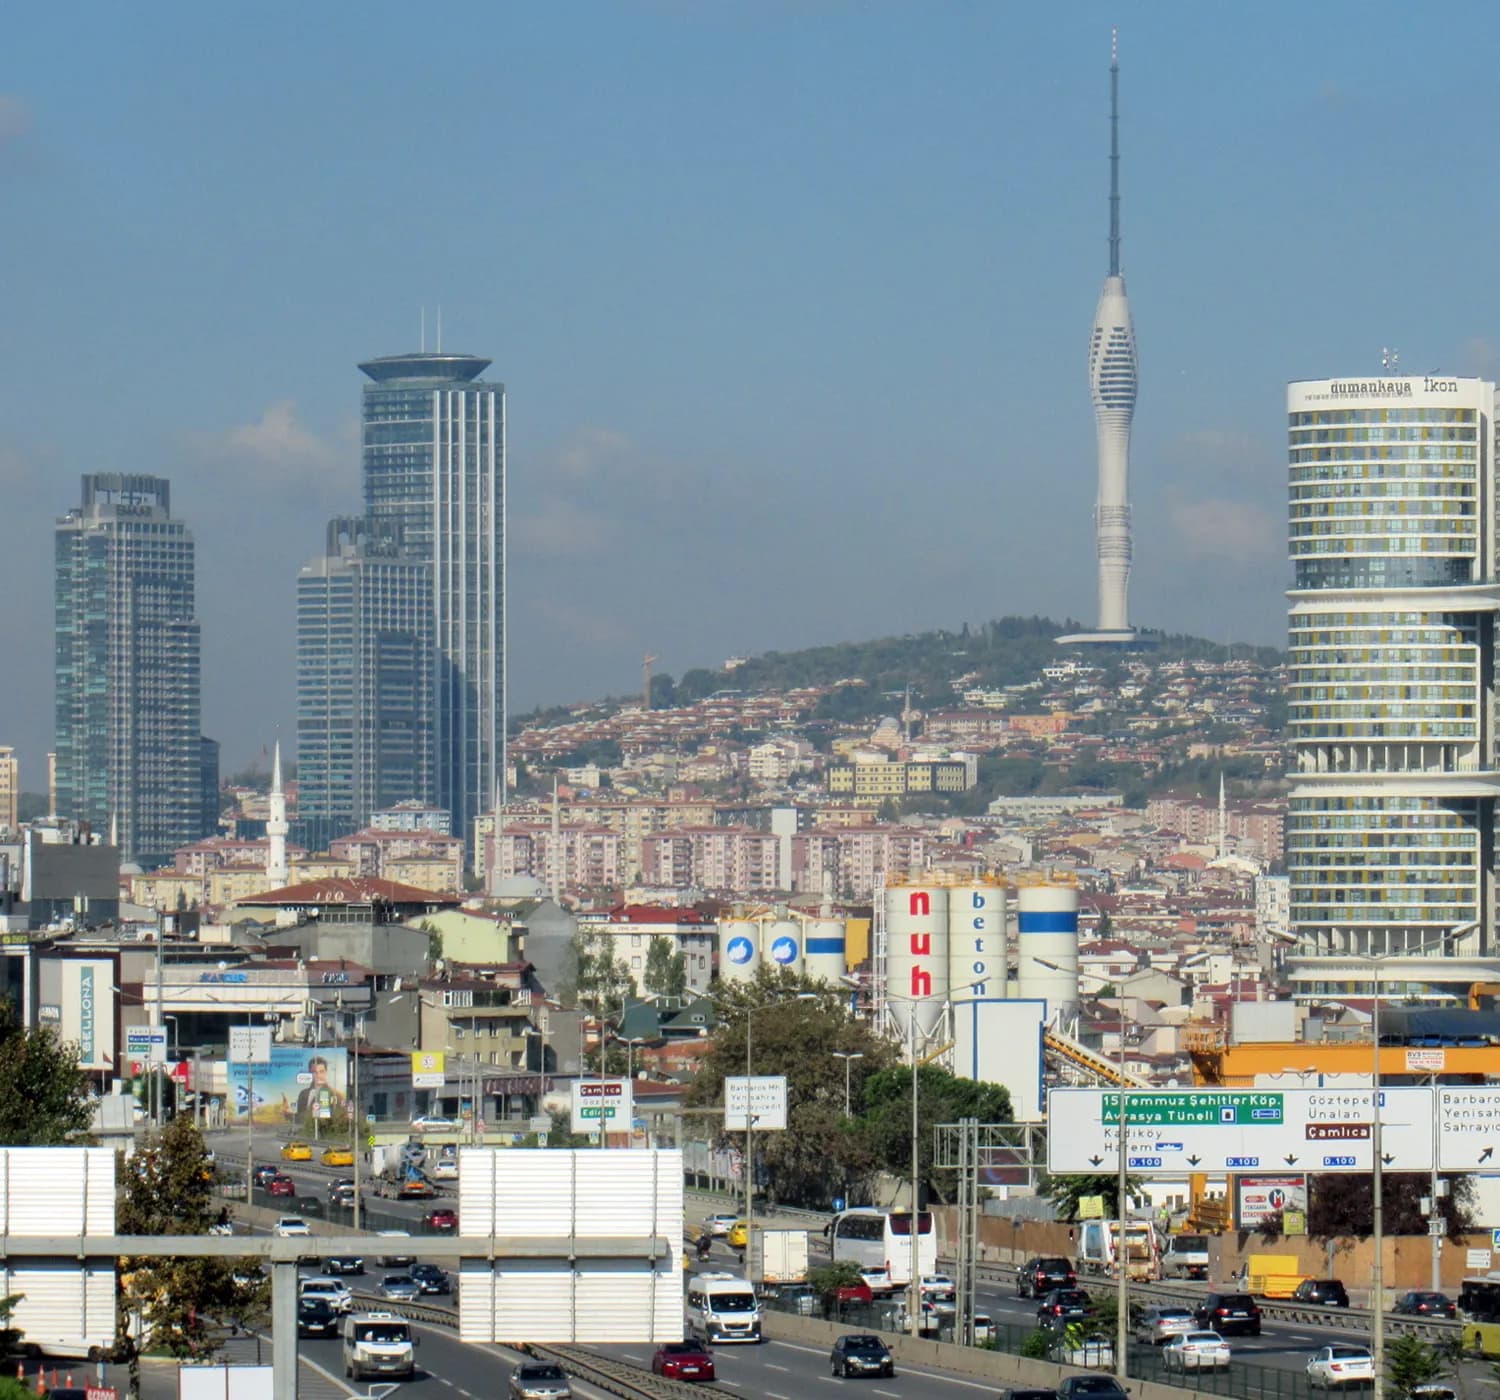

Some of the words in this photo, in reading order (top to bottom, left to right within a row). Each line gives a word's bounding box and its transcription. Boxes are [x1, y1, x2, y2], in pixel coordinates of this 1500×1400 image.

[1331, 380, 1411, 396] dumankaya
[909, 892, 931, 996] nuh
[972, 891, 986, 996] beton
[581, 1087, 621, 1095] Çamıca
[1103, 1096, 1119, 1106] 15
[1123, 1096, 1186, 1107] Temmuz
[1189, 1095, 1247, 1109] Şehitler
[1249, 1095, 1281, 1109] Köp.
[1308, 1095, 1370, 1107] Göztepe
[1167, 1109, 1214, 1121] Tüneli
[1308, 1127, 1369, 1140] Çamlıca
